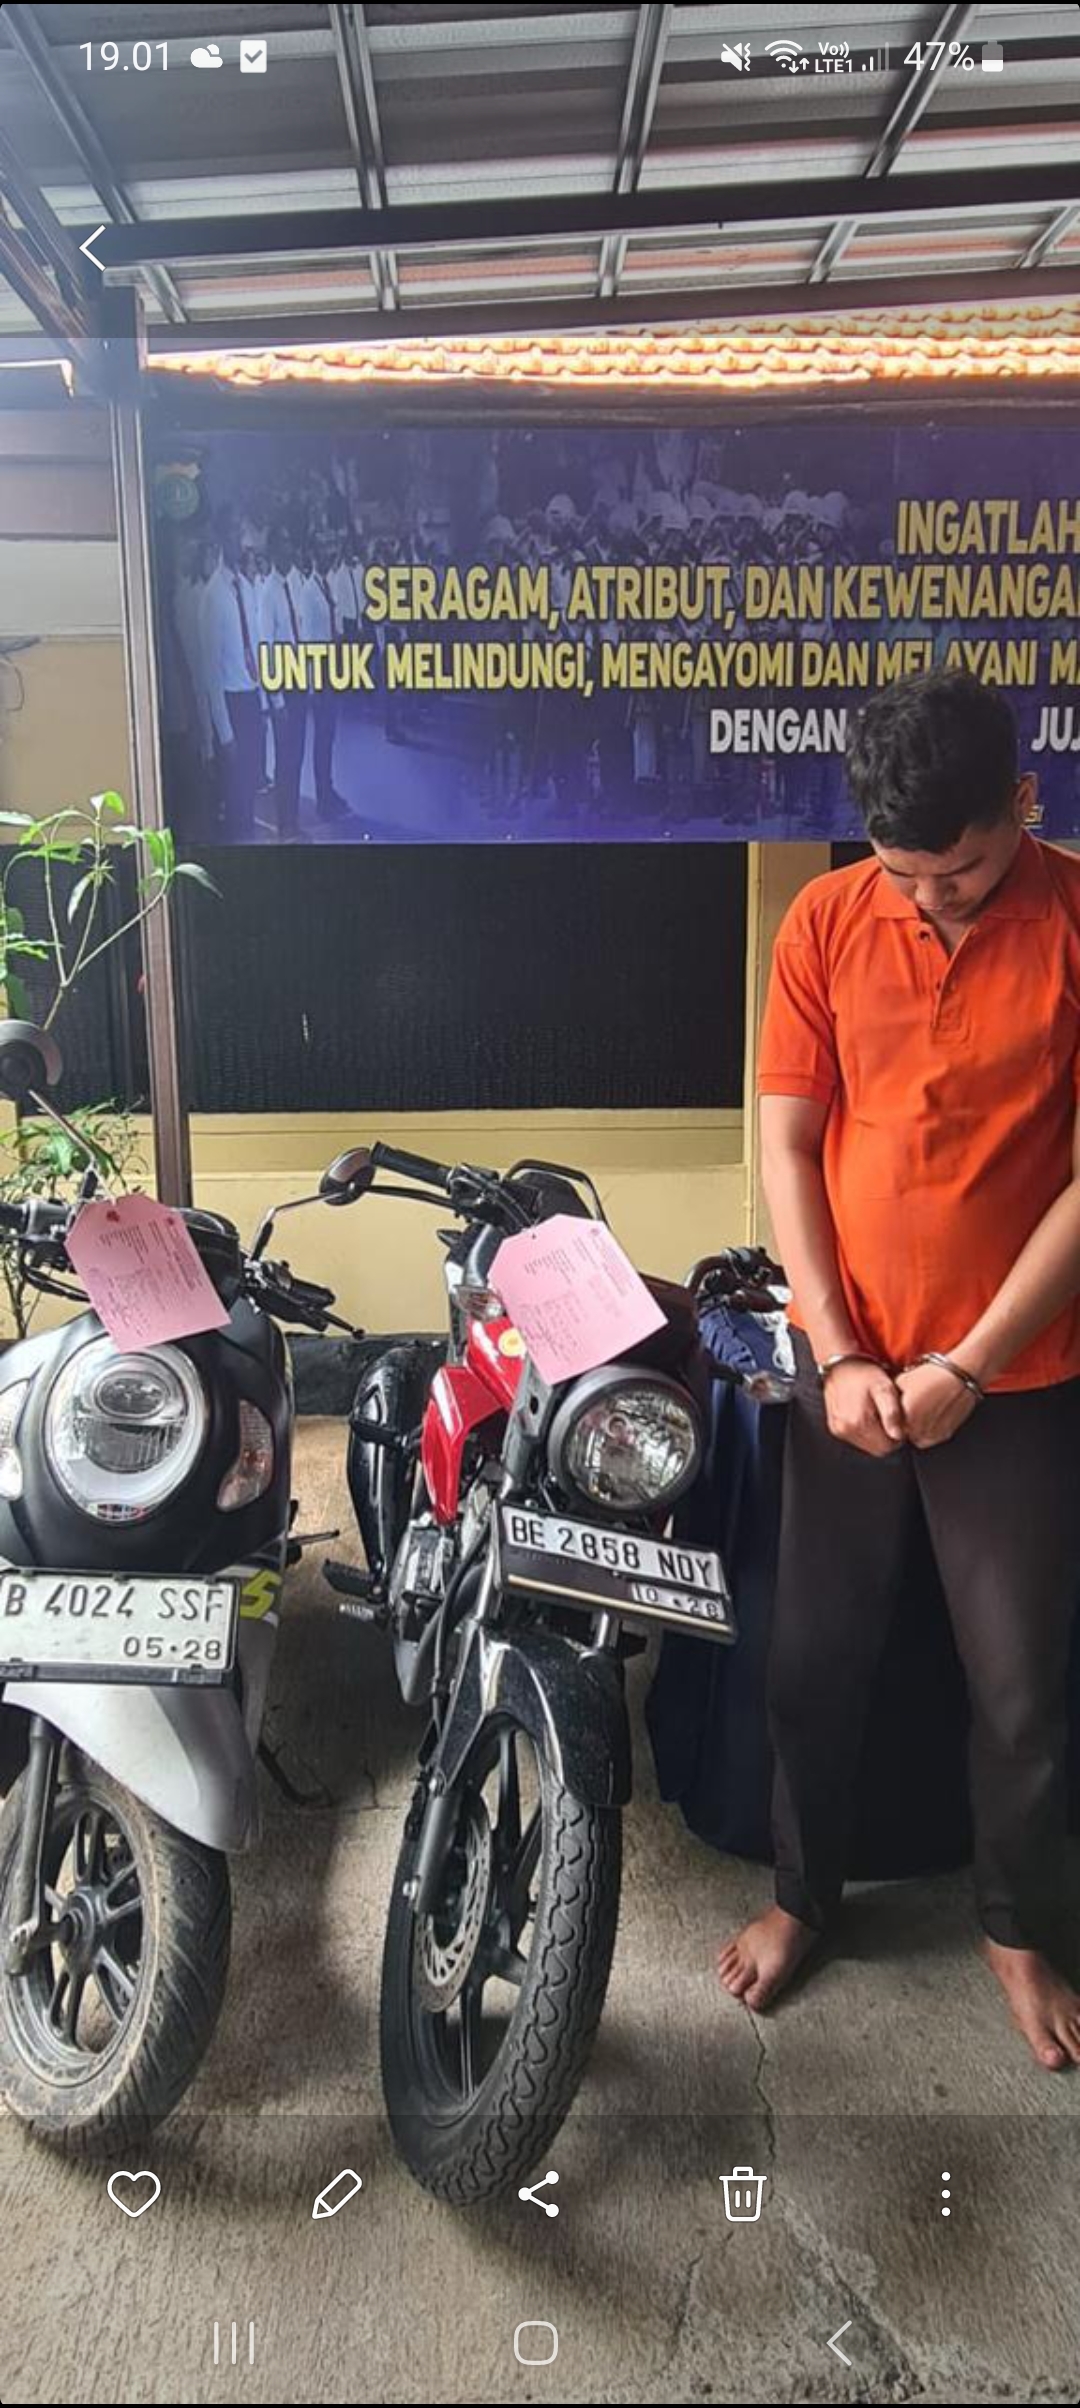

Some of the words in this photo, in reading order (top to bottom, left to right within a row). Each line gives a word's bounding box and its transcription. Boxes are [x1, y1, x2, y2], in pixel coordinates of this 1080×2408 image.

[897, 499, 1080, 555] INGATLAH
[363, 564, 561, 631] SERAGAM,
[567, 564, 737, 631] ATRIBUT,
[745, 565, 825, 621] DAN
[833, 563, 1080, 620] KEWENANGA
[259, 642, 375, 691] UNTUK
[387, 642, 594, 698] MELINDUNGI,
[601, 641, 795, 690] MENGAYOMI
[801, 640, 870, 688] DAN
[709, 708, 847, 754] DENGAN
[511, 1515, 545, 1549] BE
[557, 1527, 641, 1570] 2858
[657, 1550, 713, 1587] NDY
[4, 1583, 27, 1617] B
[44, 1583, 136, 1619] 4024
[157, 1586, 224, 1623] SSF
